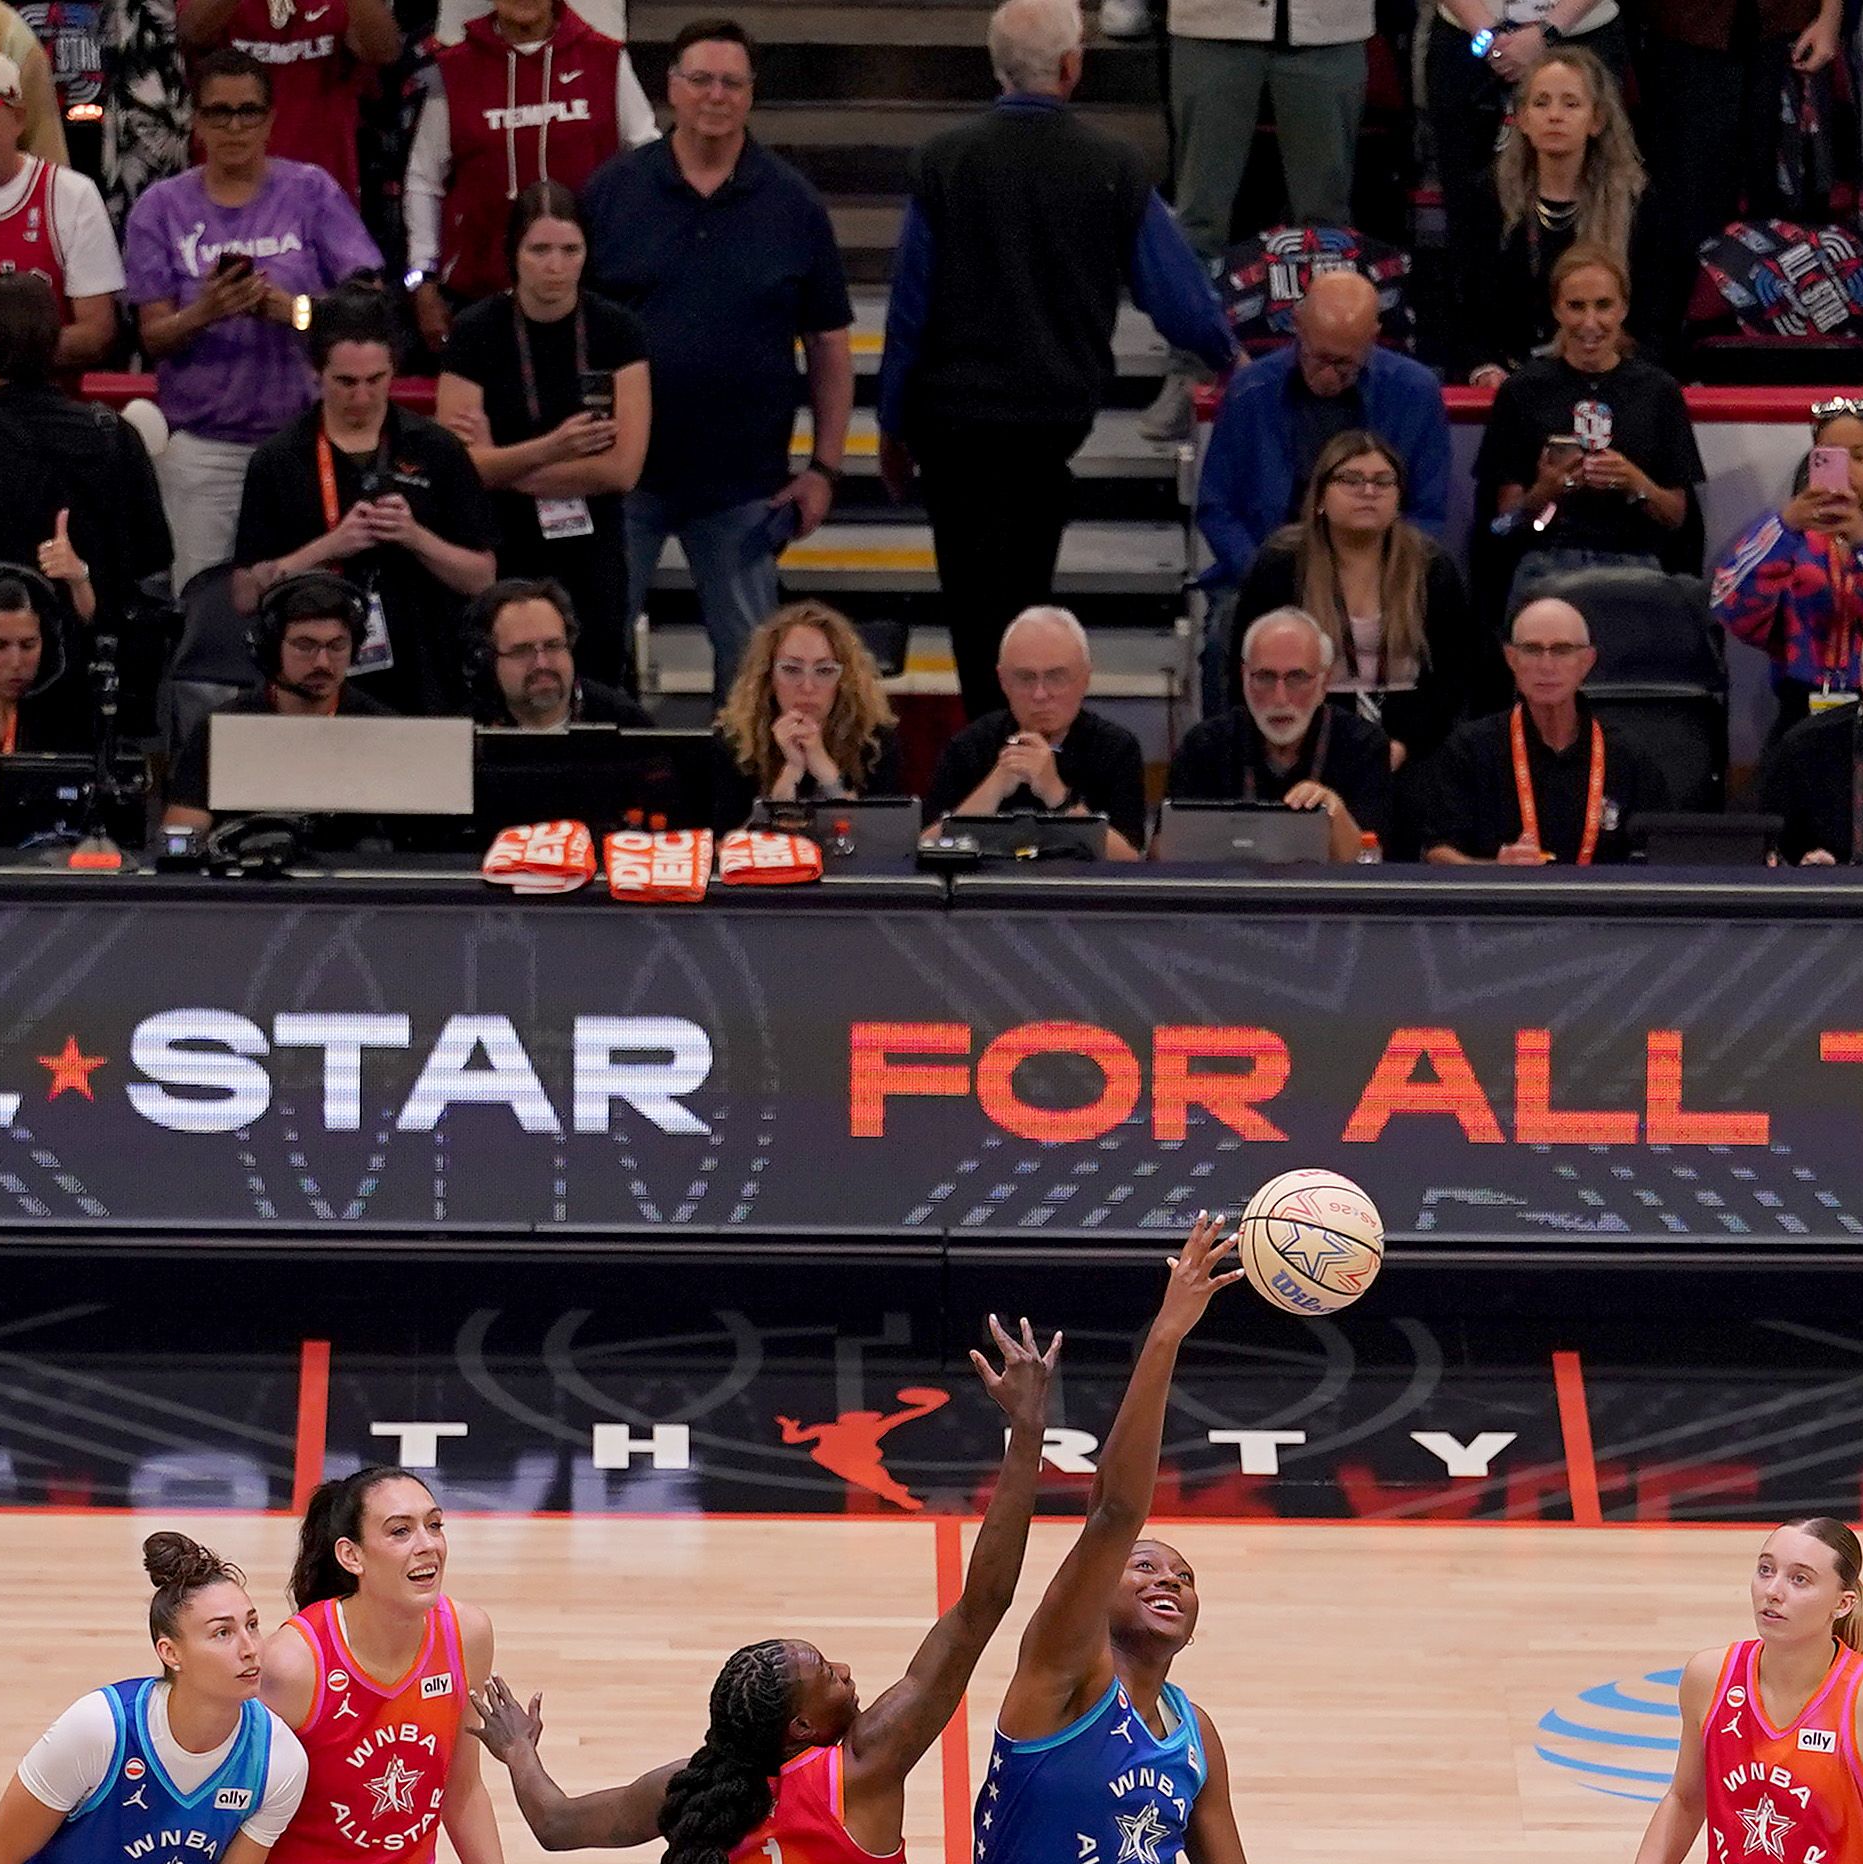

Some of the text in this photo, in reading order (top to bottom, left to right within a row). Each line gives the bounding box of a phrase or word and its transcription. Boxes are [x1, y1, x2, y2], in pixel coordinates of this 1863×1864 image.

[482, 98, 591, 130] TEMPLE
[199, 231, 302, 263] WNBA
[125, 1007, 720, 1137] STAR
[849, 1021, 1291, 1144] FOR
[1341, 1026, 1770, 1147] ALL
[1271, 1269, 1340, 1313] Wilso
[424, 1676, 449, 1695] ally
[345, 1722, 438, 1770] WNBA
[1802, 1732, 1832, 1751] ally
[218, 1790, 249, 1808] ally
[1107, 1766, 1187, 1822] WNBA
[1722, 1761, 1812, 1809] WNBA
[329, 1787, 445, 1852] ALL-STAR
[122, 1828, 220, 1861] WNBA
